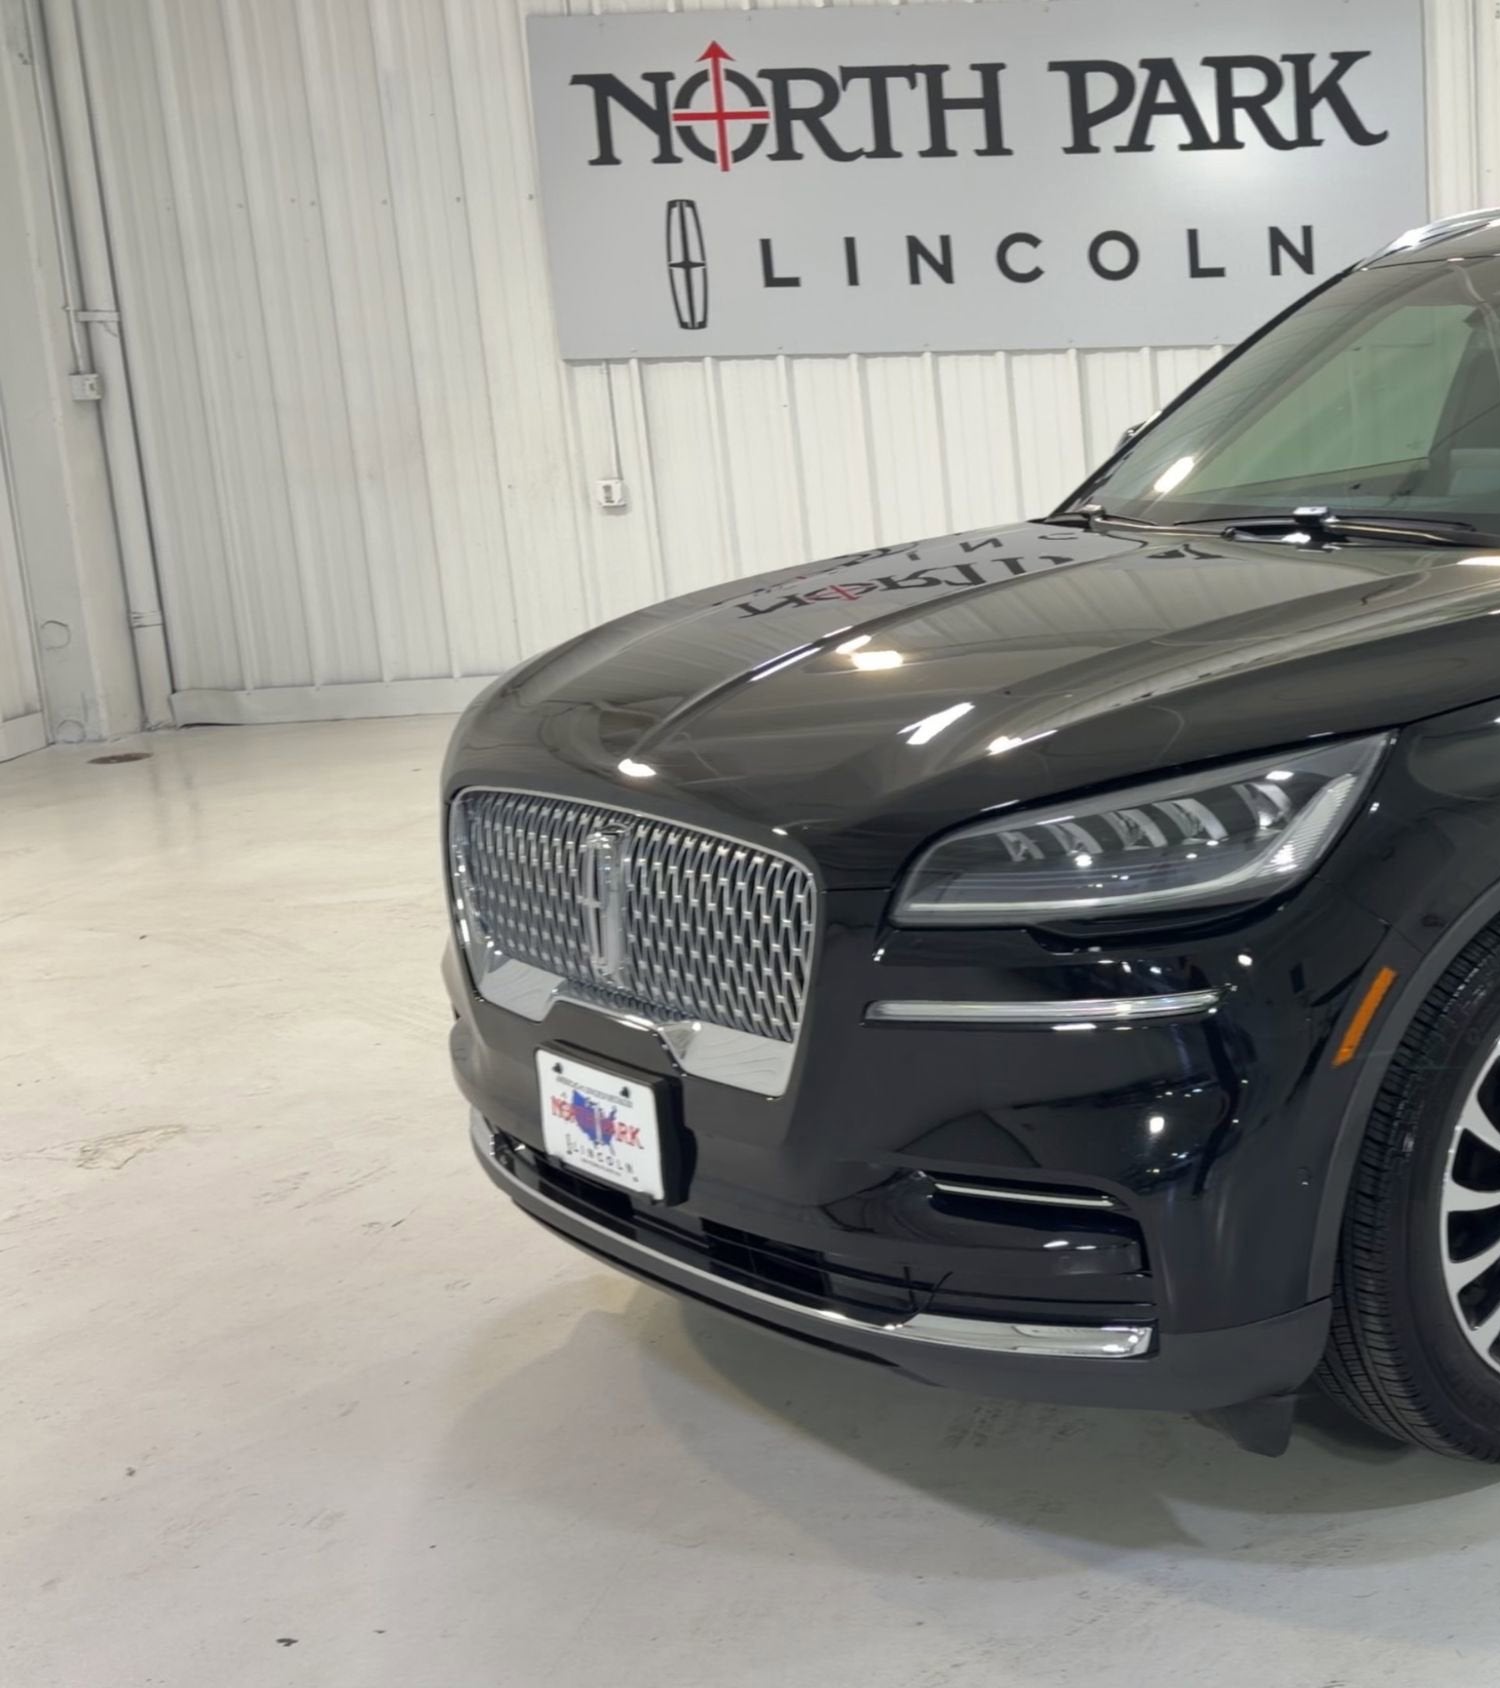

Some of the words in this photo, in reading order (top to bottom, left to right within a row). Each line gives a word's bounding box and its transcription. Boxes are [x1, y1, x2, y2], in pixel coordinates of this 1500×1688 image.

[570, 62, 1013, 169] NORTH
[1048, 51, 1389, 155] PARK
[759, 225, 1316, 289] LINCOLN
[573, 1141, 634, 1174] LINCOLN
